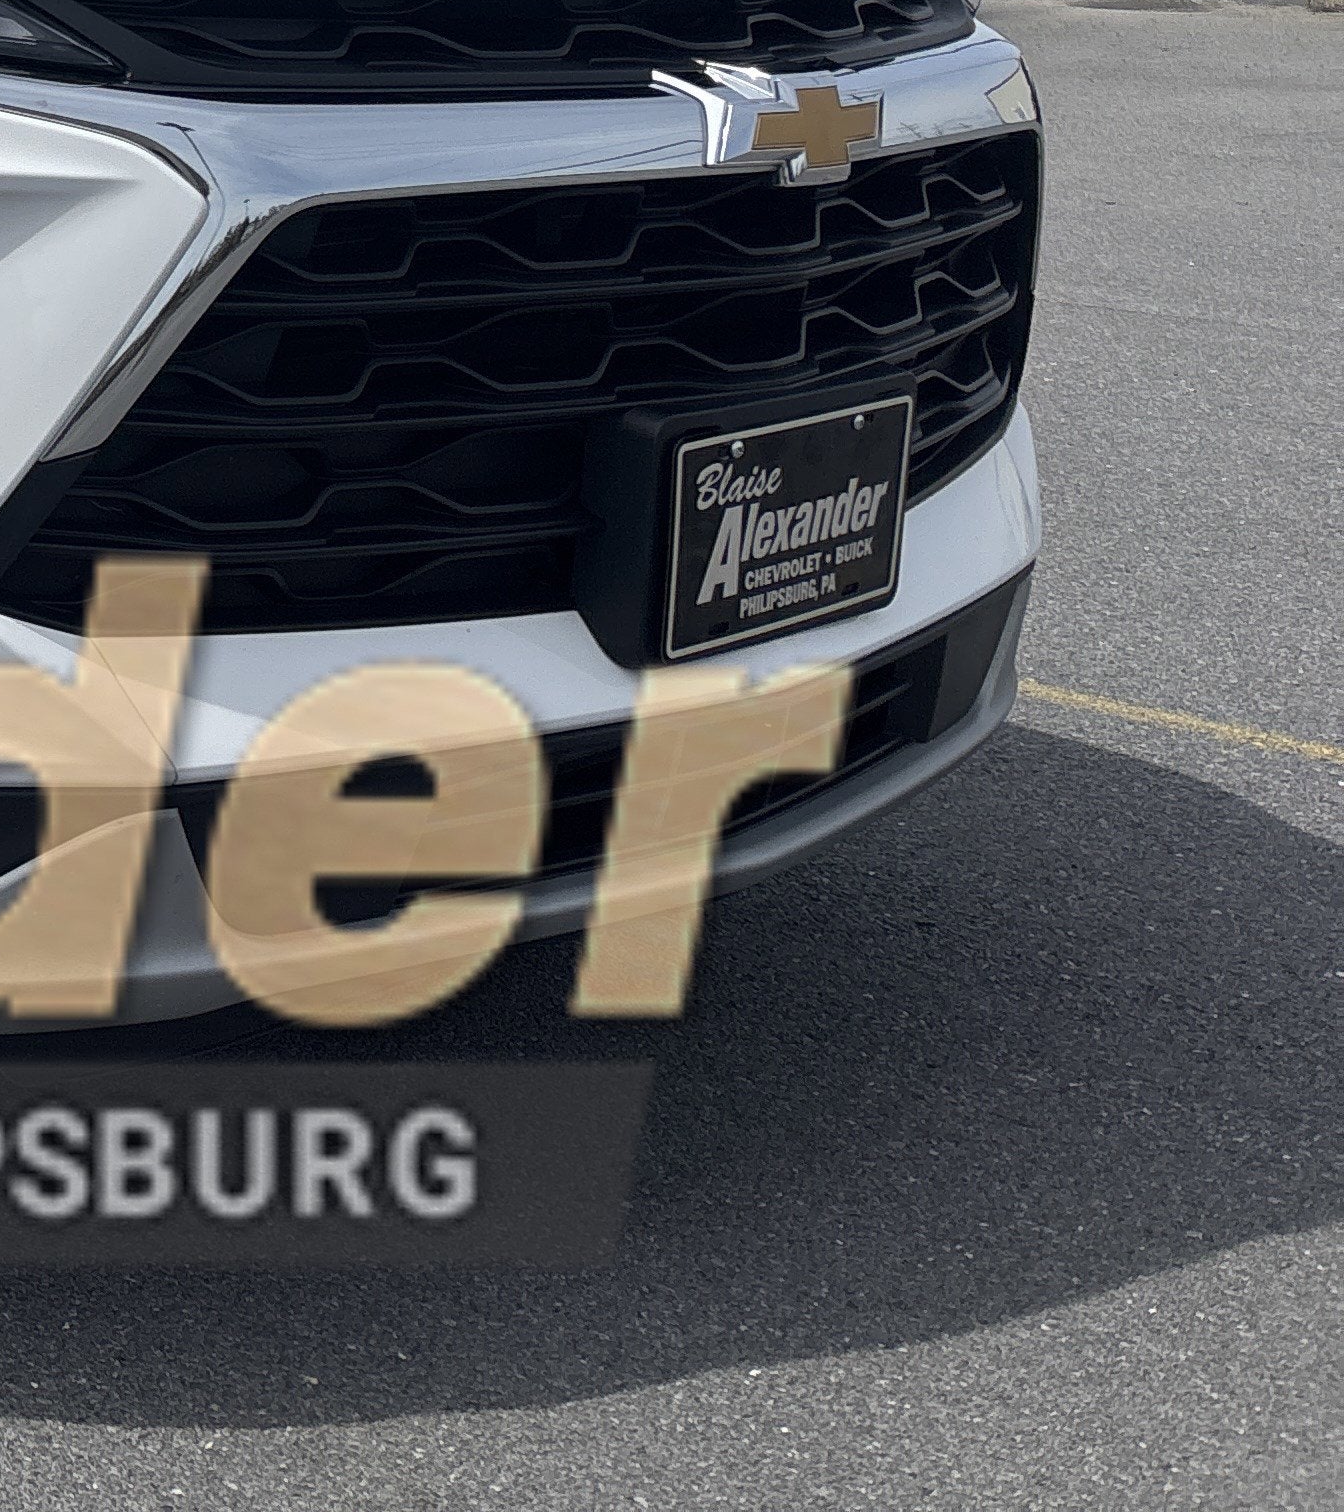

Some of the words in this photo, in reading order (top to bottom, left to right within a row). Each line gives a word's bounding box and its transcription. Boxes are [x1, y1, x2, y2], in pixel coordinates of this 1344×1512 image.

[695, 463, 783, 511] Blaise
[695, 477, 890, 606] Alexander
[745, 551, 822, 591] CHEVROLET
[835, 537, 874, 566] BUICK
[739, 582, 818, 619] PHILIPSBURG,
[820, 573, 837, 595] PA
